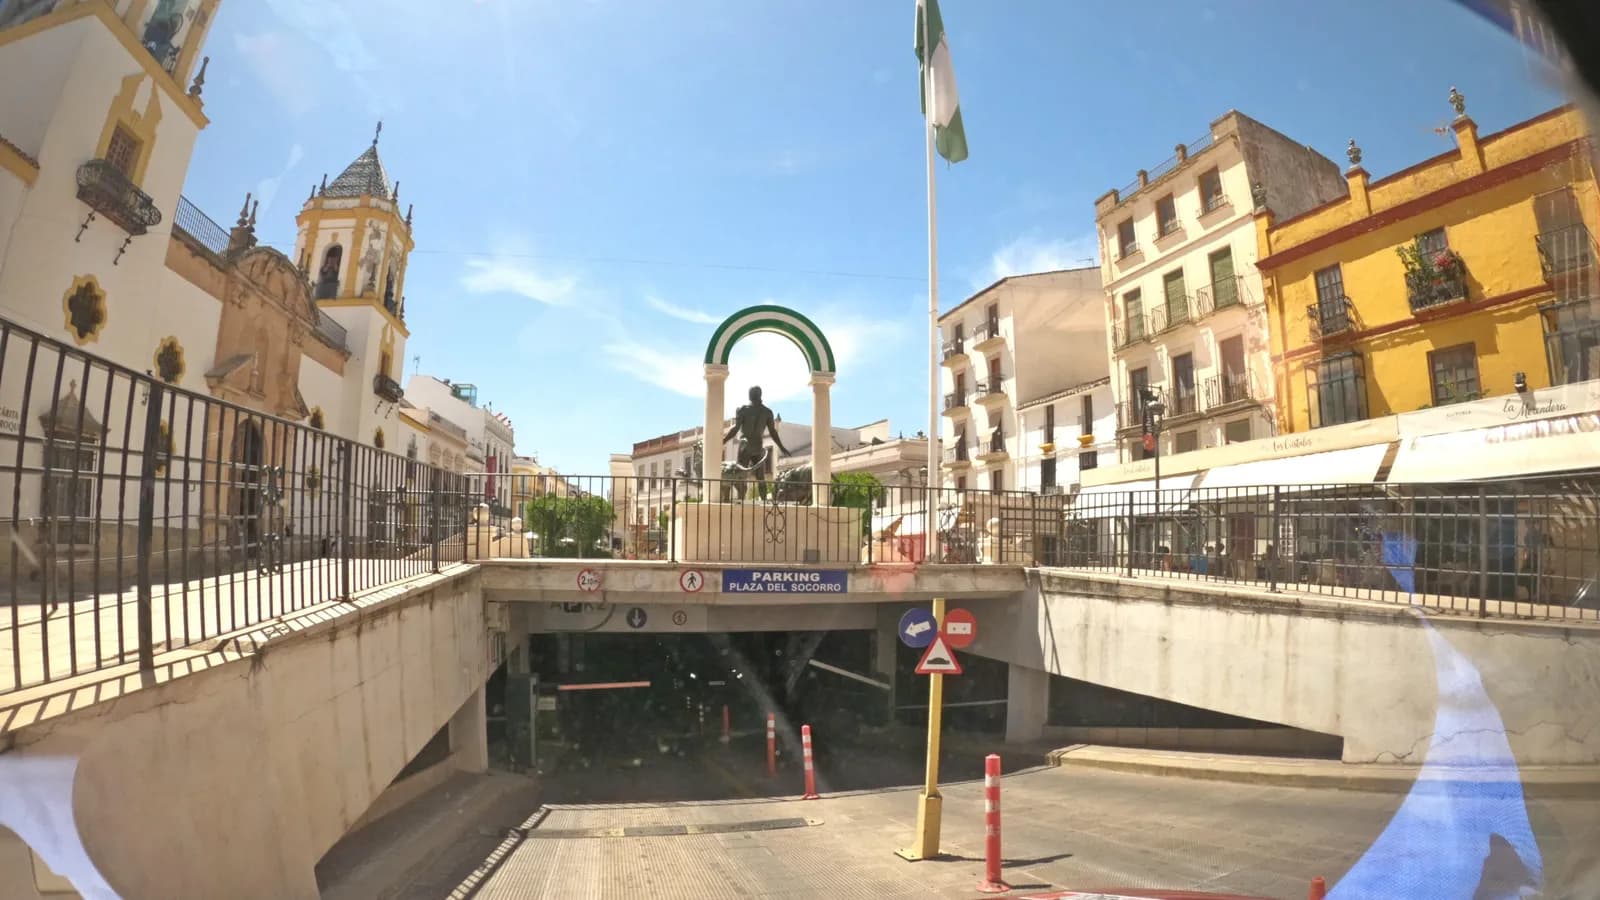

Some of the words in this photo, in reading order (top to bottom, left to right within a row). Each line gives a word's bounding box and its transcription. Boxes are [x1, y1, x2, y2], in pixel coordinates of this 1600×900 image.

[752, 571, 820, 582] PARKING
[729, 582, 764, 592] PLAZA
[767, 583, 787, 592] DEL
[791, 583, 841, 592] SOCORRO
